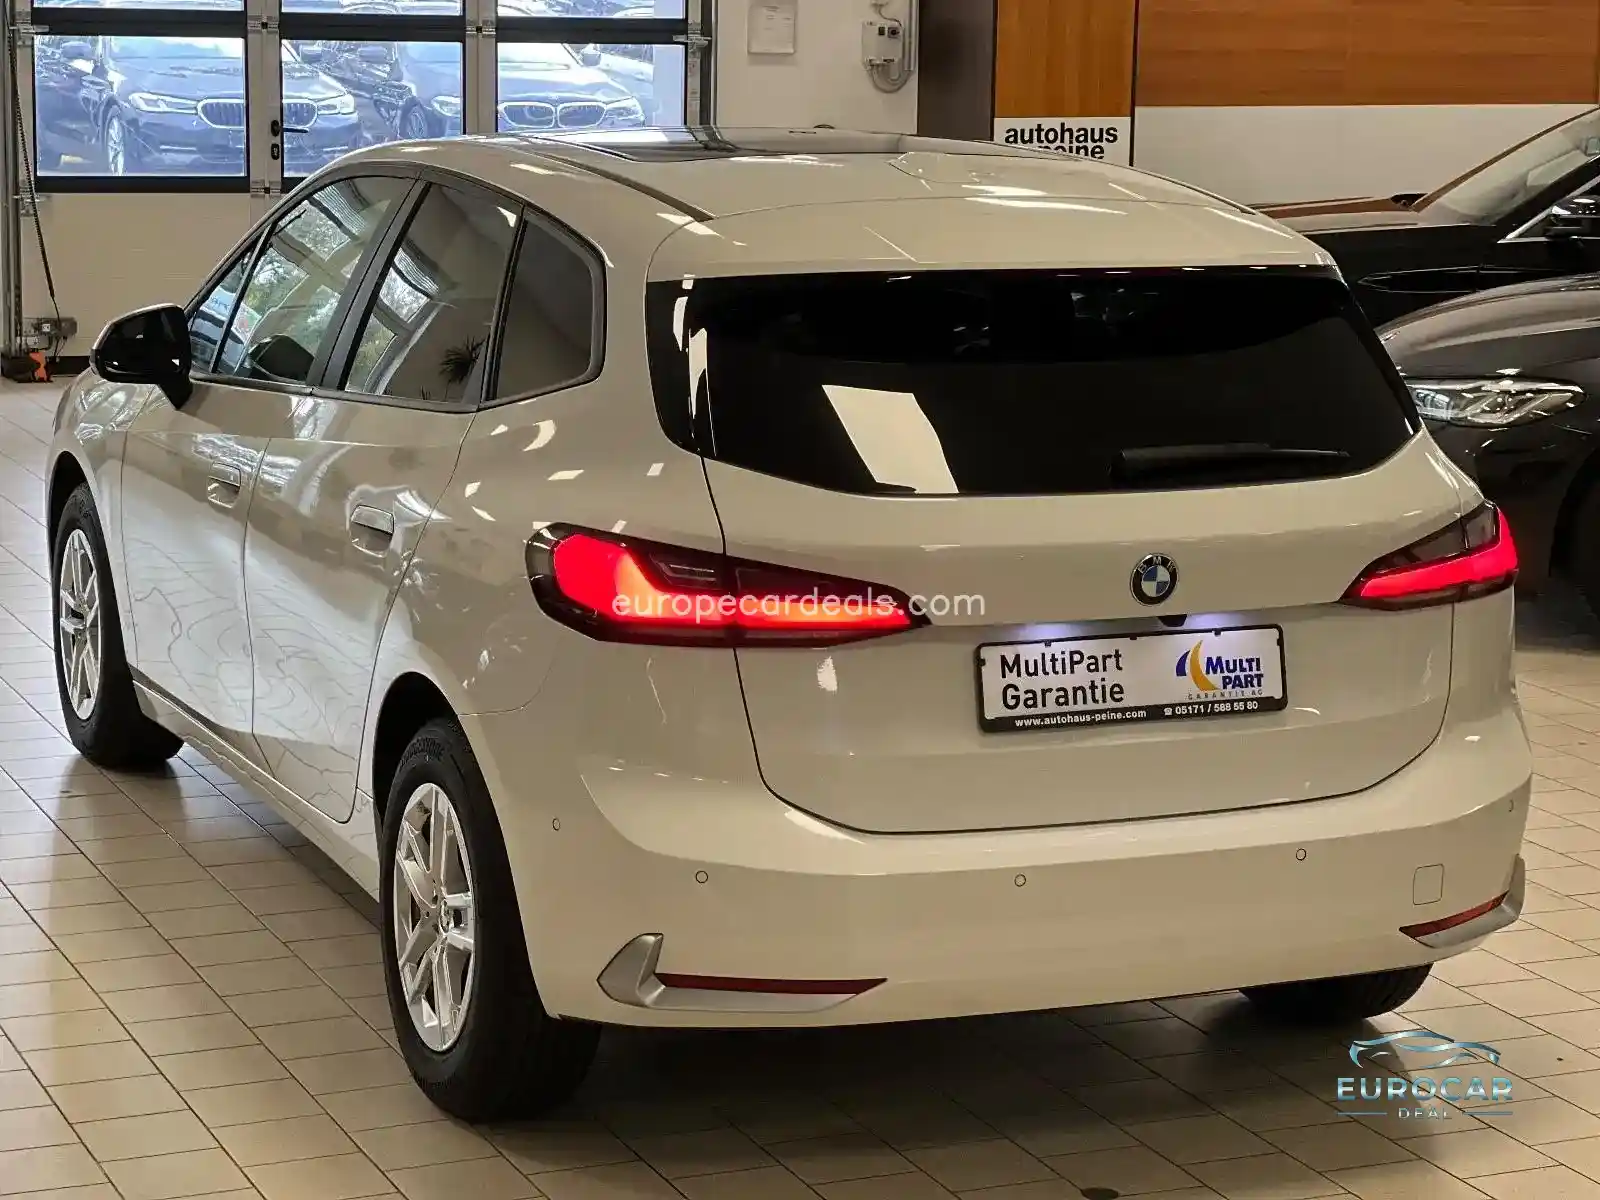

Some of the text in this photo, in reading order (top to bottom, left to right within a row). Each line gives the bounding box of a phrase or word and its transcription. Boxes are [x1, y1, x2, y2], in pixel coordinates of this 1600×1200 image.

[1004, 122, 1118, 144] autohaus
[1137, 556, 1176, 573] BMW
[1000, 649, 1123, 679] MultiPart
[1205, 656, 1261, 675] MULTI
[1221, 674, 1264, 689] PART
[1002, 678, 1124, 710] Garantie
[1175, 704, 1205, 715] 05171
[1214, 702, 1232, 713] 588
[1233, 701, 1245, 711] 55
[1246, 701, 1259, 710] 80
[1015, 709, 1147, 727] www.autohaus-peine.com
